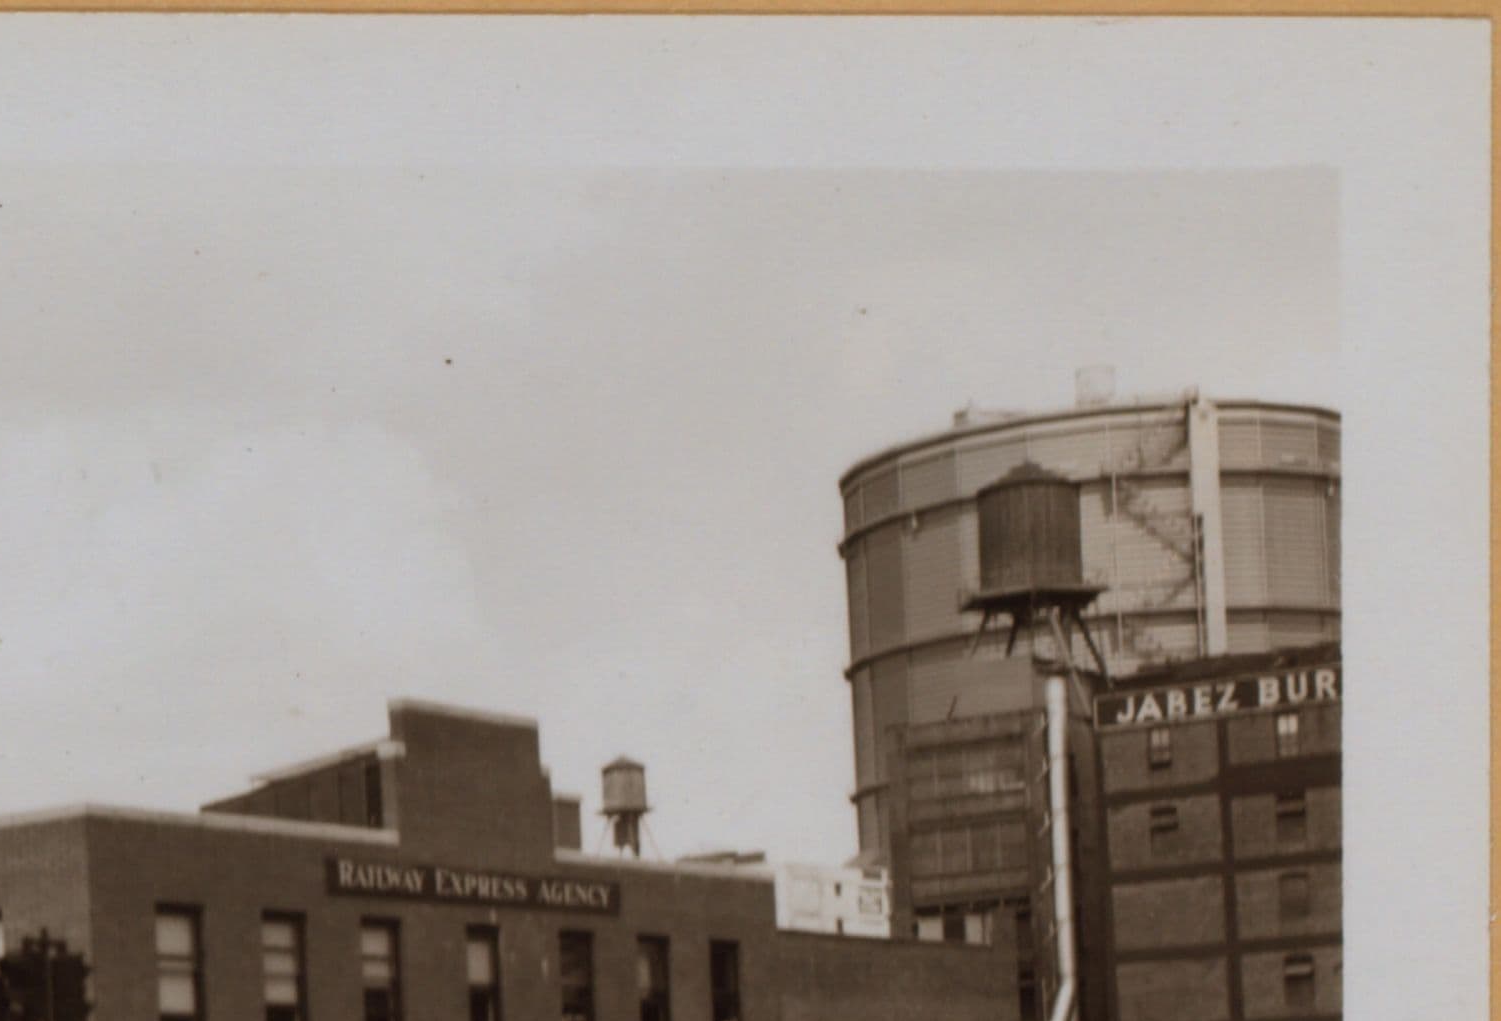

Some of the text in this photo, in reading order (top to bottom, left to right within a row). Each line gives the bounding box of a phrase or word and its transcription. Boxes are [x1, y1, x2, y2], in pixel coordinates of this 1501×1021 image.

[1115, 668, 1338, 724] JABEZ BUR
[337, 859, 611, 908] RAILWAY EXPRESS AGENCY
